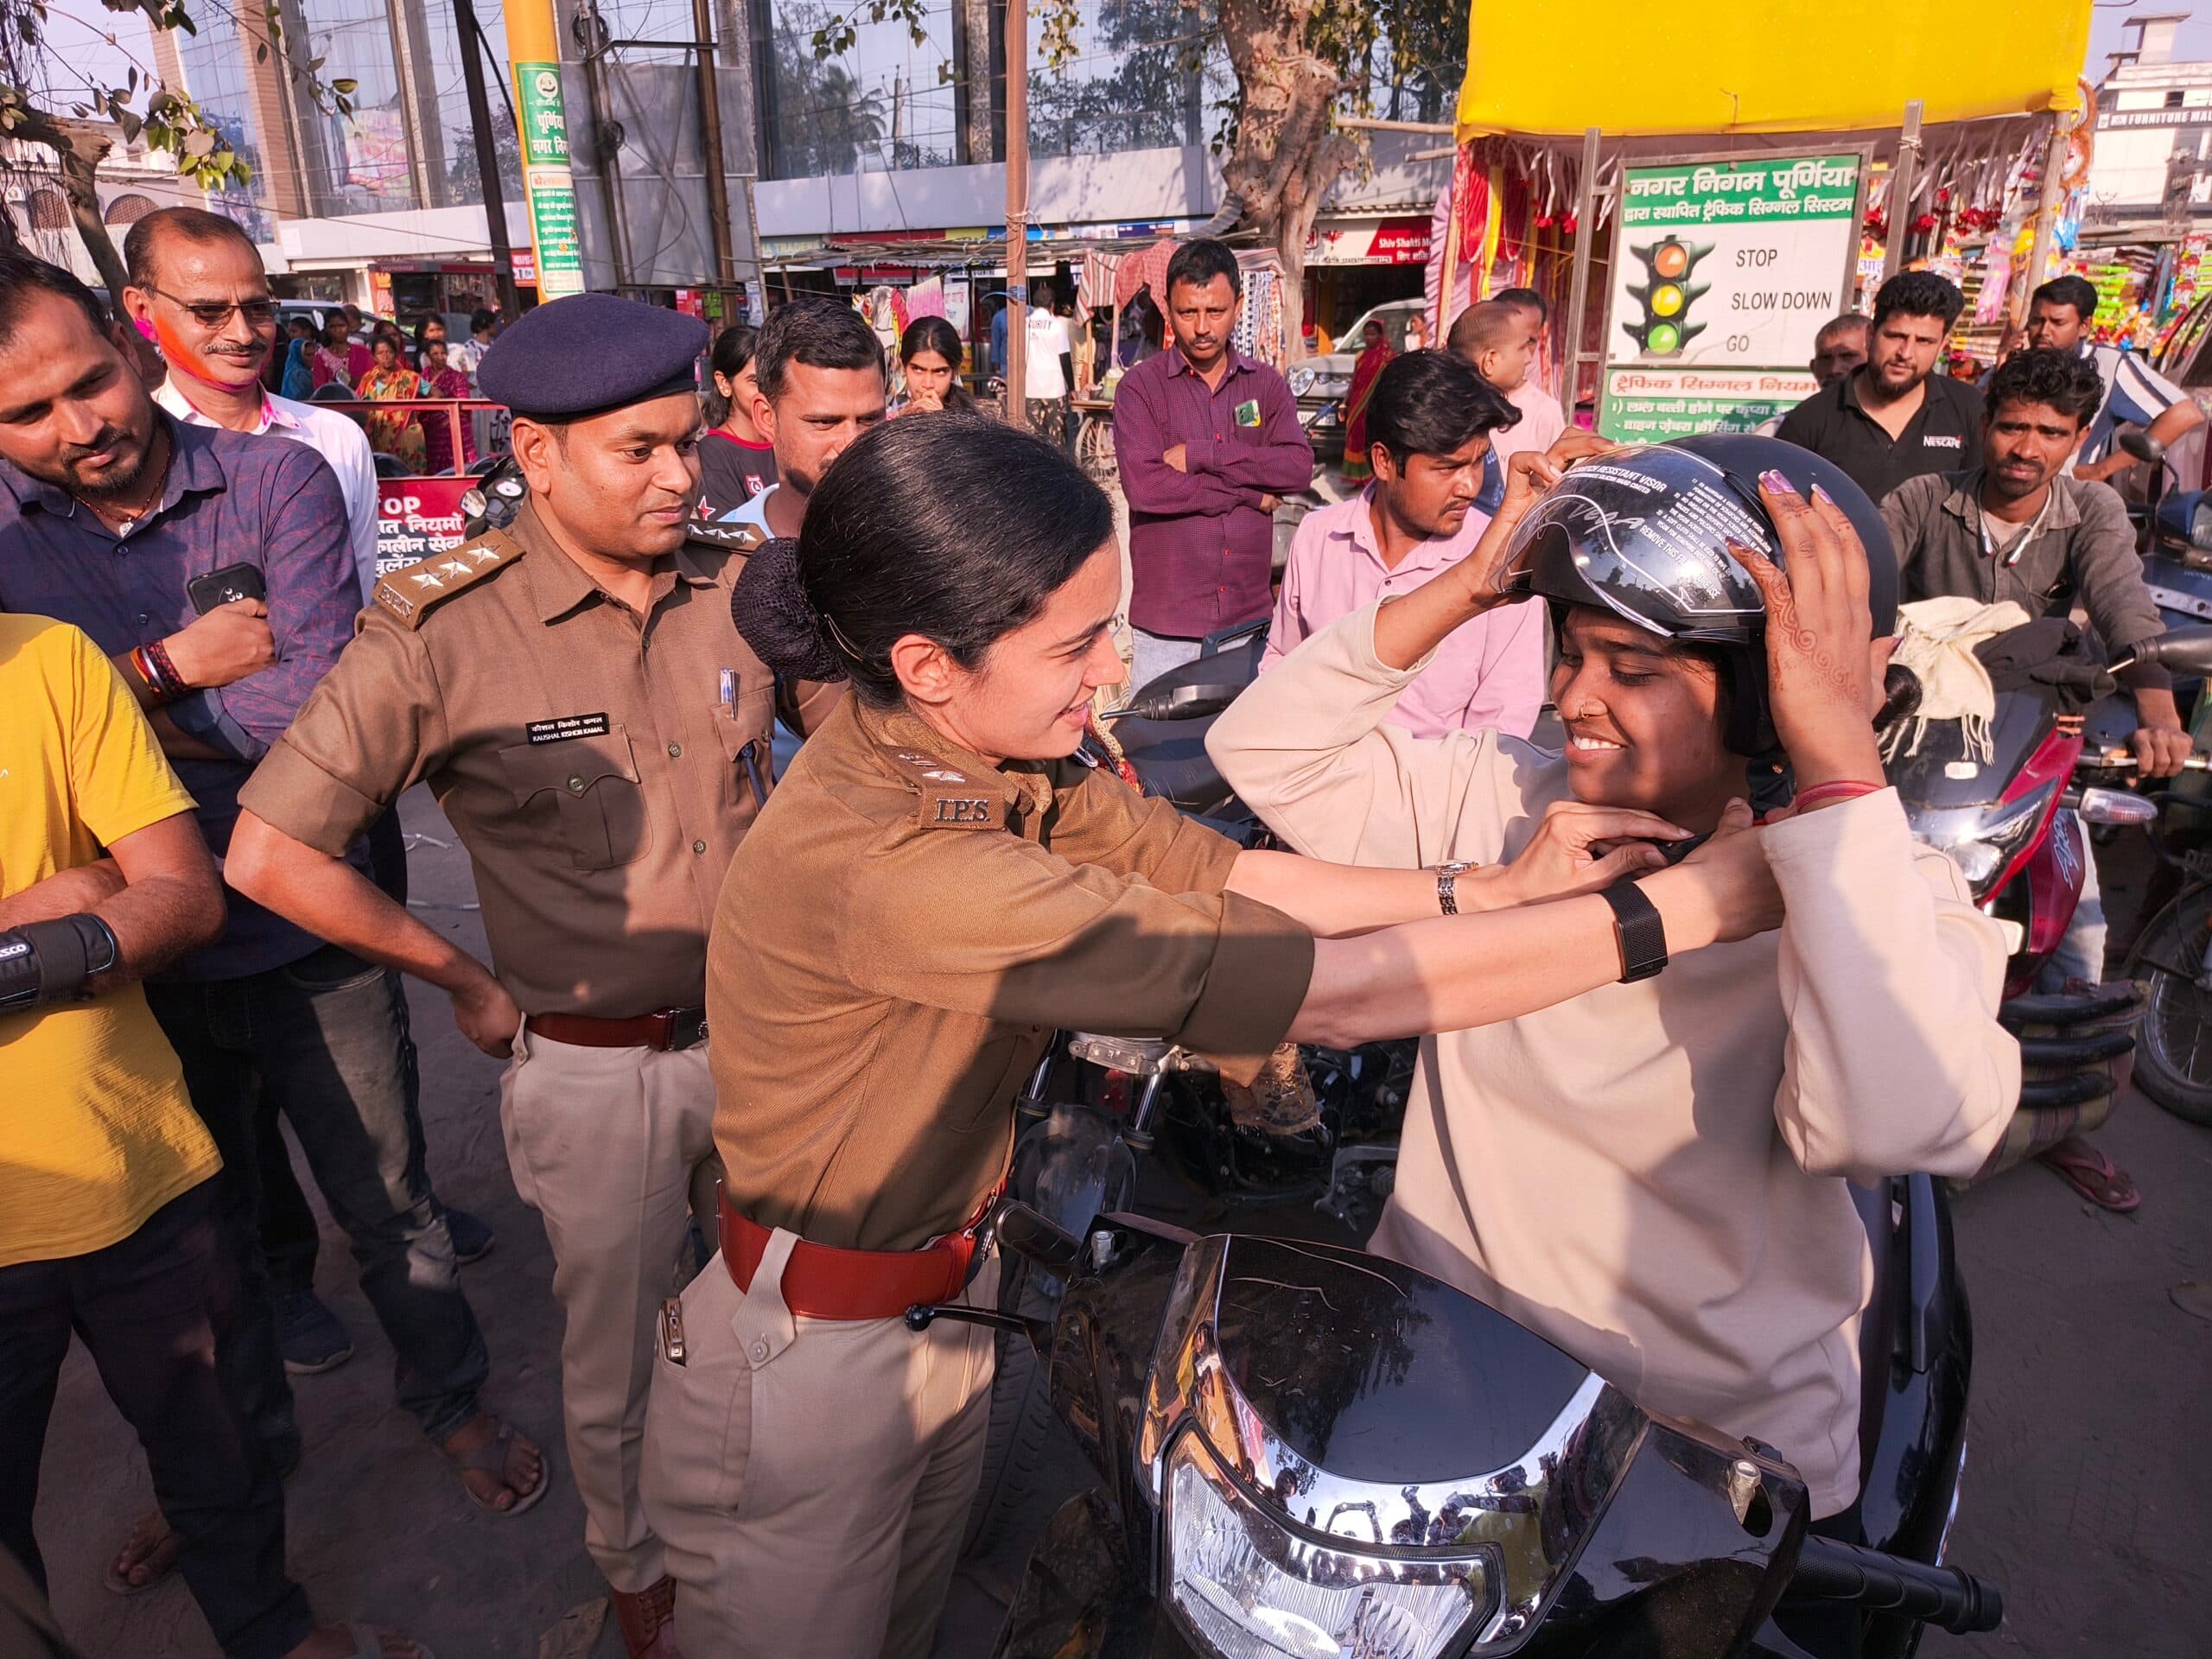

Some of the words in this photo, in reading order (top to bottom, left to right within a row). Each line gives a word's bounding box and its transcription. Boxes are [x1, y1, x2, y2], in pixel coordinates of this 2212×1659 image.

[2128, 111, 2190, 125] FURNITURE
[553, 136, 569, 154] निग
[1630, 176, 1688, 197] नगर
[1693, 167, 1766, 194] निगम
[1772, 160, 1855, 200] पूर्णिया
[1624, 207, 1650, 221] द्वारा
[1653, 200, 1700, 219] स्थापित
[1748, 197, 1801, 215] सिग्नल
[1803, 194, 1854, 213] सिस्टम
[1736, 250, 1777, 267] STOP
[1732, 294, 1777, 309] SLOW
[1782, 292, 1832, 309] DOWN
[1726, 335, 1750, 353] GO
[1681, 376, 1751, 391] सिग्नल
[1627, 402, 1654, 413] लाल
[1630, 482, 1651, 494] COATED
[1638, 475, 1668, 493] VISOR
[1639, 524, 1666, 548] REMOVE
[1662, 543, 1679, 558] THIS
